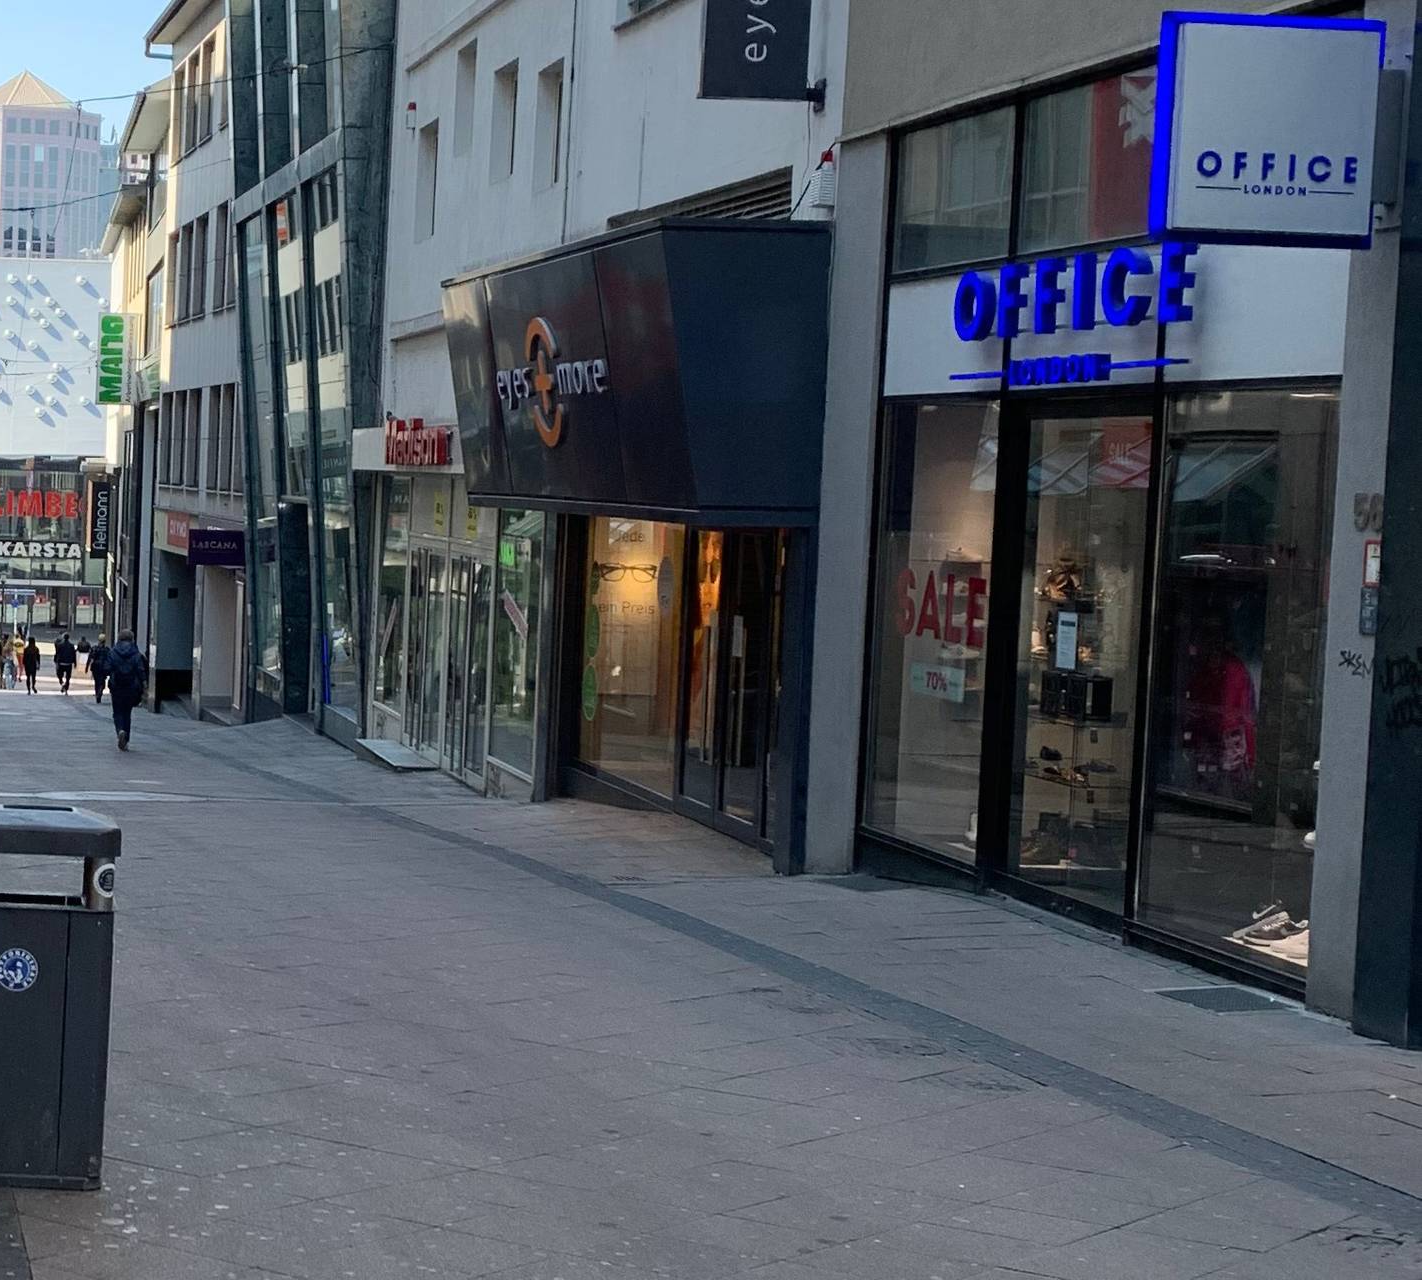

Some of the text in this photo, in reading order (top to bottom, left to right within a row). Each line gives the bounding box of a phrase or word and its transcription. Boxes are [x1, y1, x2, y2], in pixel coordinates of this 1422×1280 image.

[1196, 150, 1358, 184] OFFICE
[1243, 184, 1307, 197] LONDON
[954, 241, 1201, 342] OFFICE
[497, 359, 607, 410] eyes more
[1009, 354, 1112, 386] LONDON
[93, 490, 108, 550] fielmann
[894, 567, 987, 649] SALE
[925, 670, 948, 692] 70%
